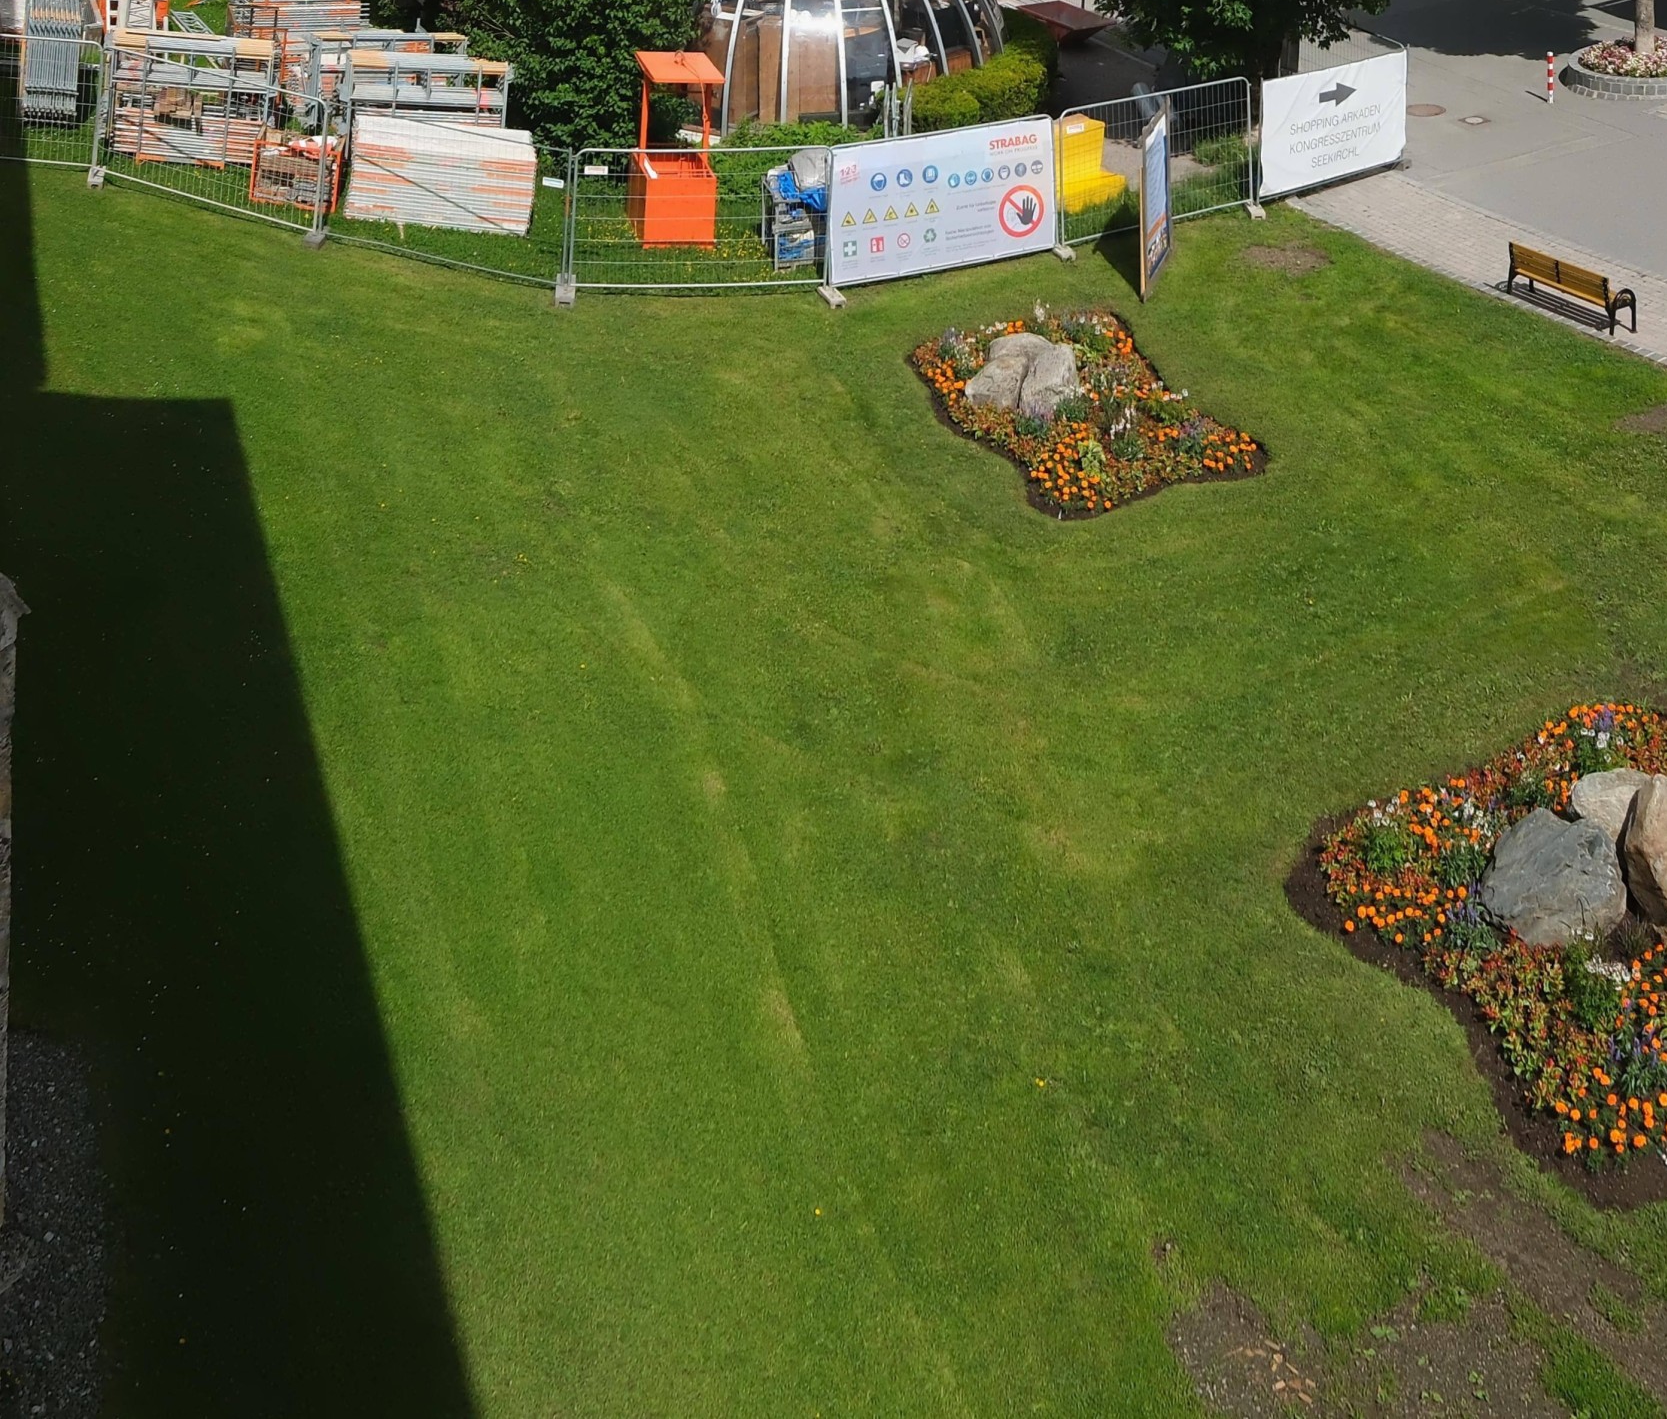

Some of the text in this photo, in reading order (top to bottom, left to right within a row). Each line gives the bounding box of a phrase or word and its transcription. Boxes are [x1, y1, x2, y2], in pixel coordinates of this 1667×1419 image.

[1290, 104, 1381, 135] SHOPPING ARKADEN
[989, 133, 1038, 150] STRABAG
[1289, 122, 1382, 155] KONGRESSZENTRUM
[1311, 147, 1360, 169] SEEKIRCHL
